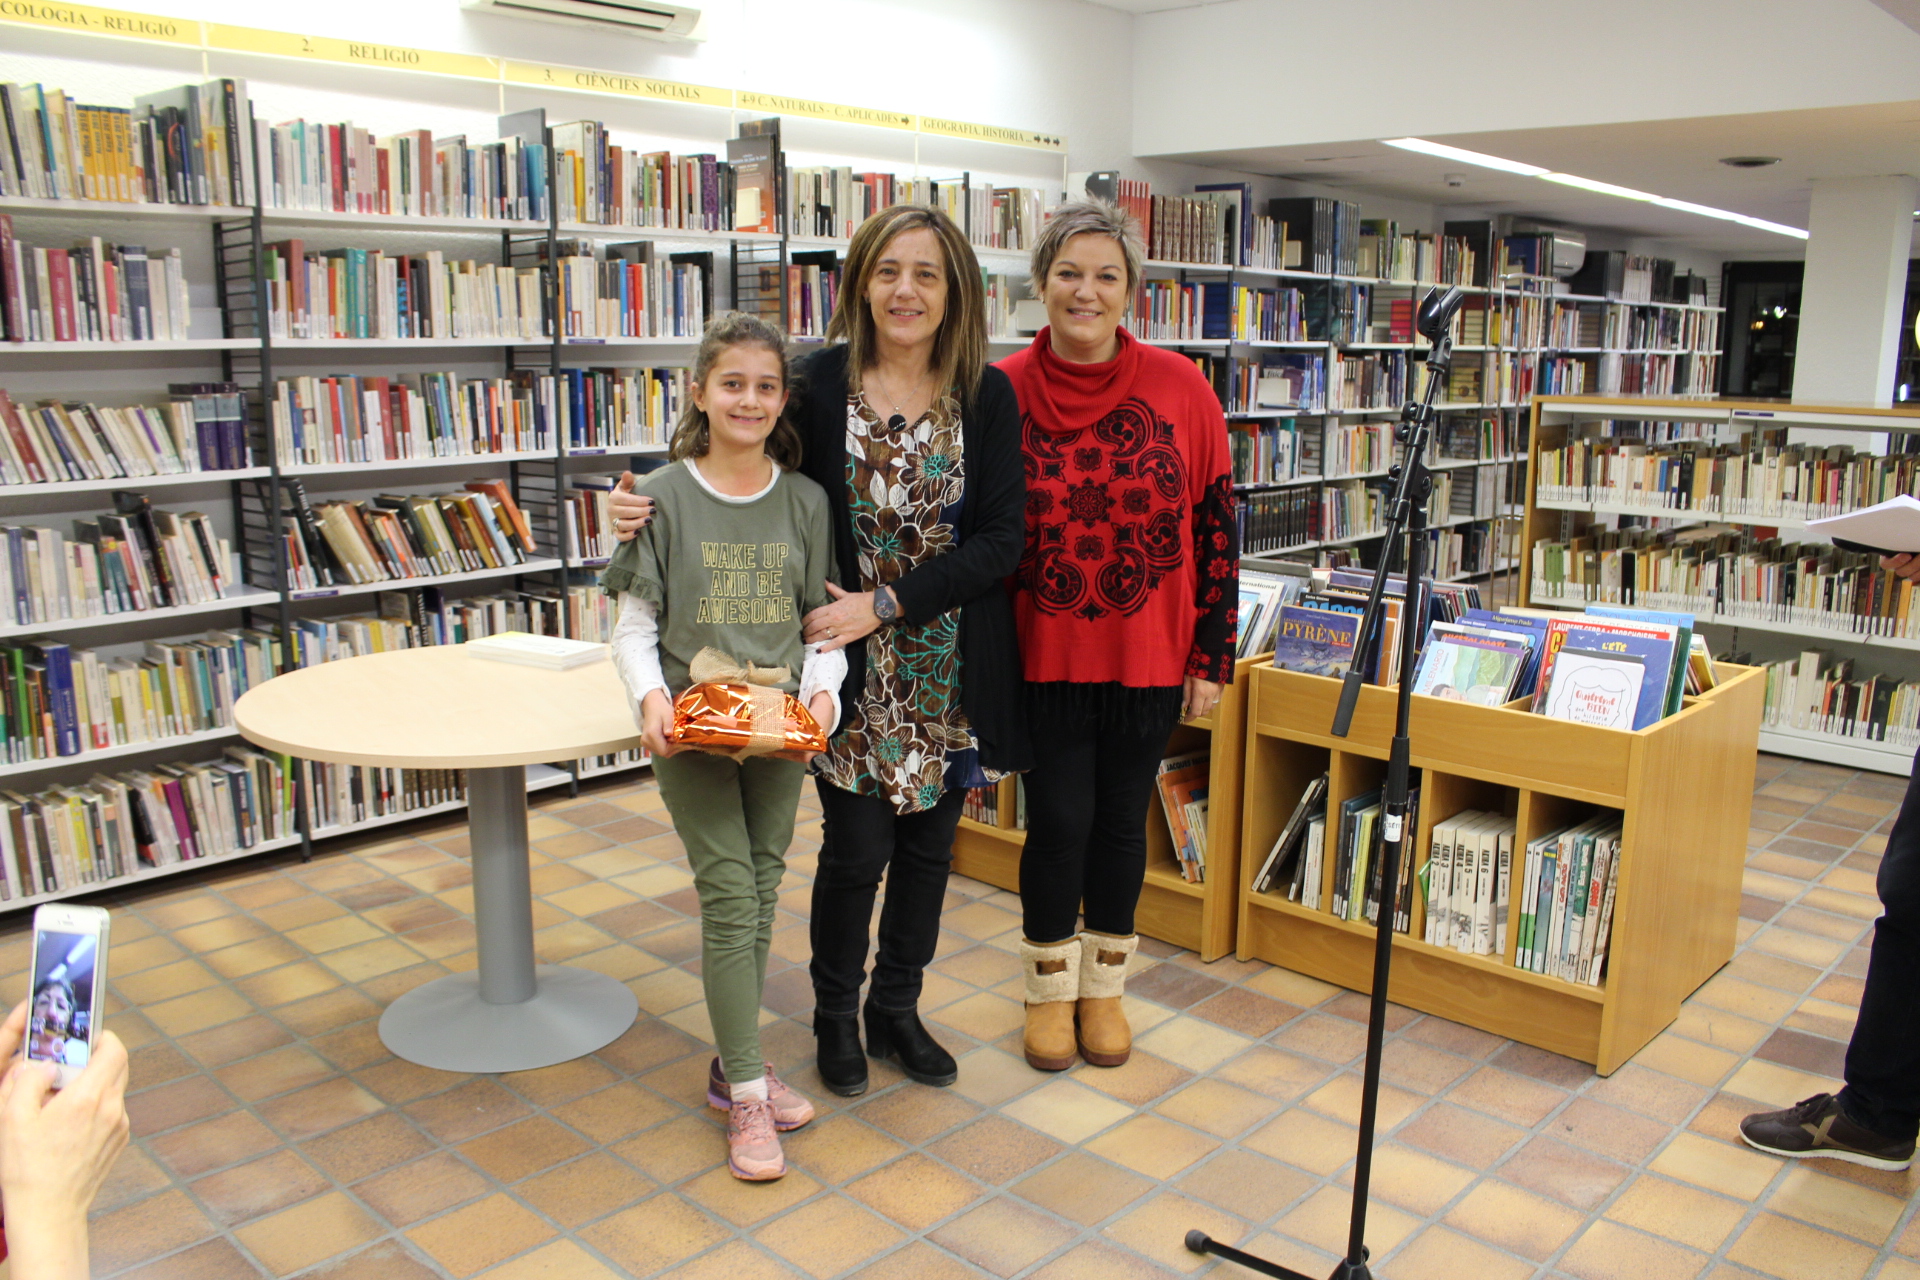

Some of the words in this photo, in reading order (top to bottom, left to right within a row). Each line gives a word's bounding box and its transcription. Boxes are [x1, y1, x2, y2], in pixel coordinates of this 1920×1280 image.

[0, 0, 89, 26] COLOGIA
[104, 15, 177, 37] RELIGIÓ
[302, 38, 314, 52] 2.
[349, 43, 420, 65] RELIGIÓ
[544, 69, 554, 82] 3.
[575, 71, 639, 91] CIÈNCIES
[645, 82, 700, 99] SOCIALS
[741, 94, 755, 104] 4-9
[758, 96, 768, 107] C.
[770, 97, 824, 114] NATURALS
[834, 105, 844, 117] C.
[846, 109, 899, 124] APLICADES
[79, 112, 89, 132] 2010
[701, 541, 756, 569] WAKE
[763, 542, 789, 569] UP
[711, 570, 750, 597] AND
[757, 570, 783, 597] BE
[696, 596, 792, 624] AWESOME
[1282, 621, 1352, 644] PYRÈNE
[1602, 642, 1628, 652] L'ÉTÉ
[1422, 648, 1445, 693] MILENARIO
[1587, 702, 1610, 715] BIEN
[1166, 760, 1191, 772] JACQUES
[1432, 842, 1440, 861] AKIRA
[1442, 843, 1451, 862] AKIRA
[1456, 843, 1465, 862] AKIRA
[1466, 849, 1474, 868] AKIRA
[1482, 849, 1490, 867] AKIRA
[1500, 850, 1509, 869] AKIRA
